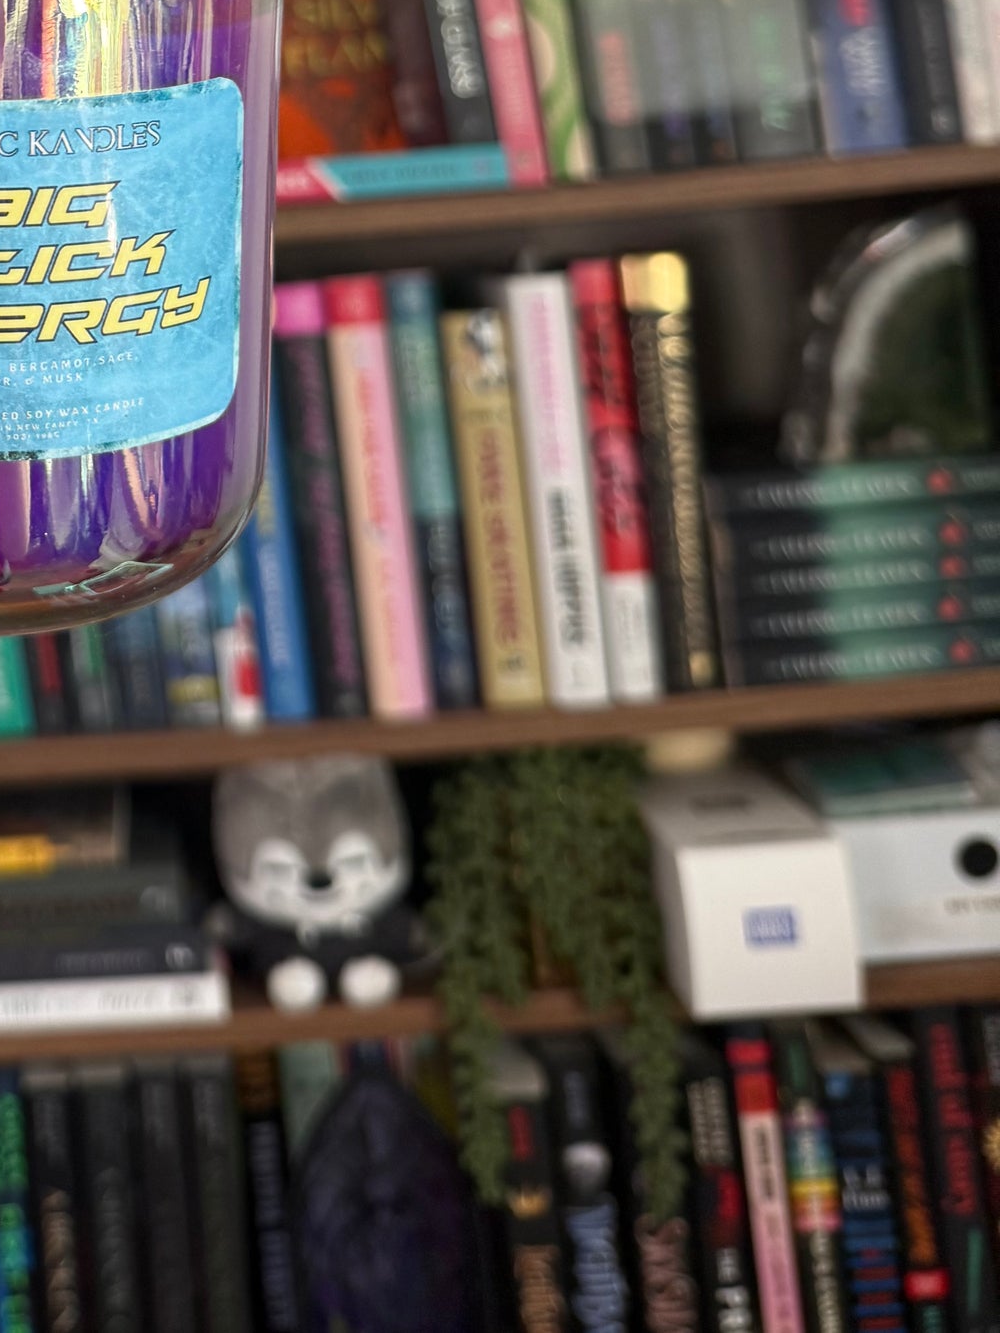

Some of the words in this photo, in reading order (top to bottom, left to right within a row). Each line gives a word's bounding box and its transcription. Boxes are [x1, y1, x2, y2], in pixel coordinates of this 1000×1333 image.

[28, 120, 161, 157] KANDLES
[42, 372, 84, 384] MUSK
[26, 410, 53, 420] SOY
[59, 406, 89, 417] WAX
[95, 397, 145, 413] CANDLE
